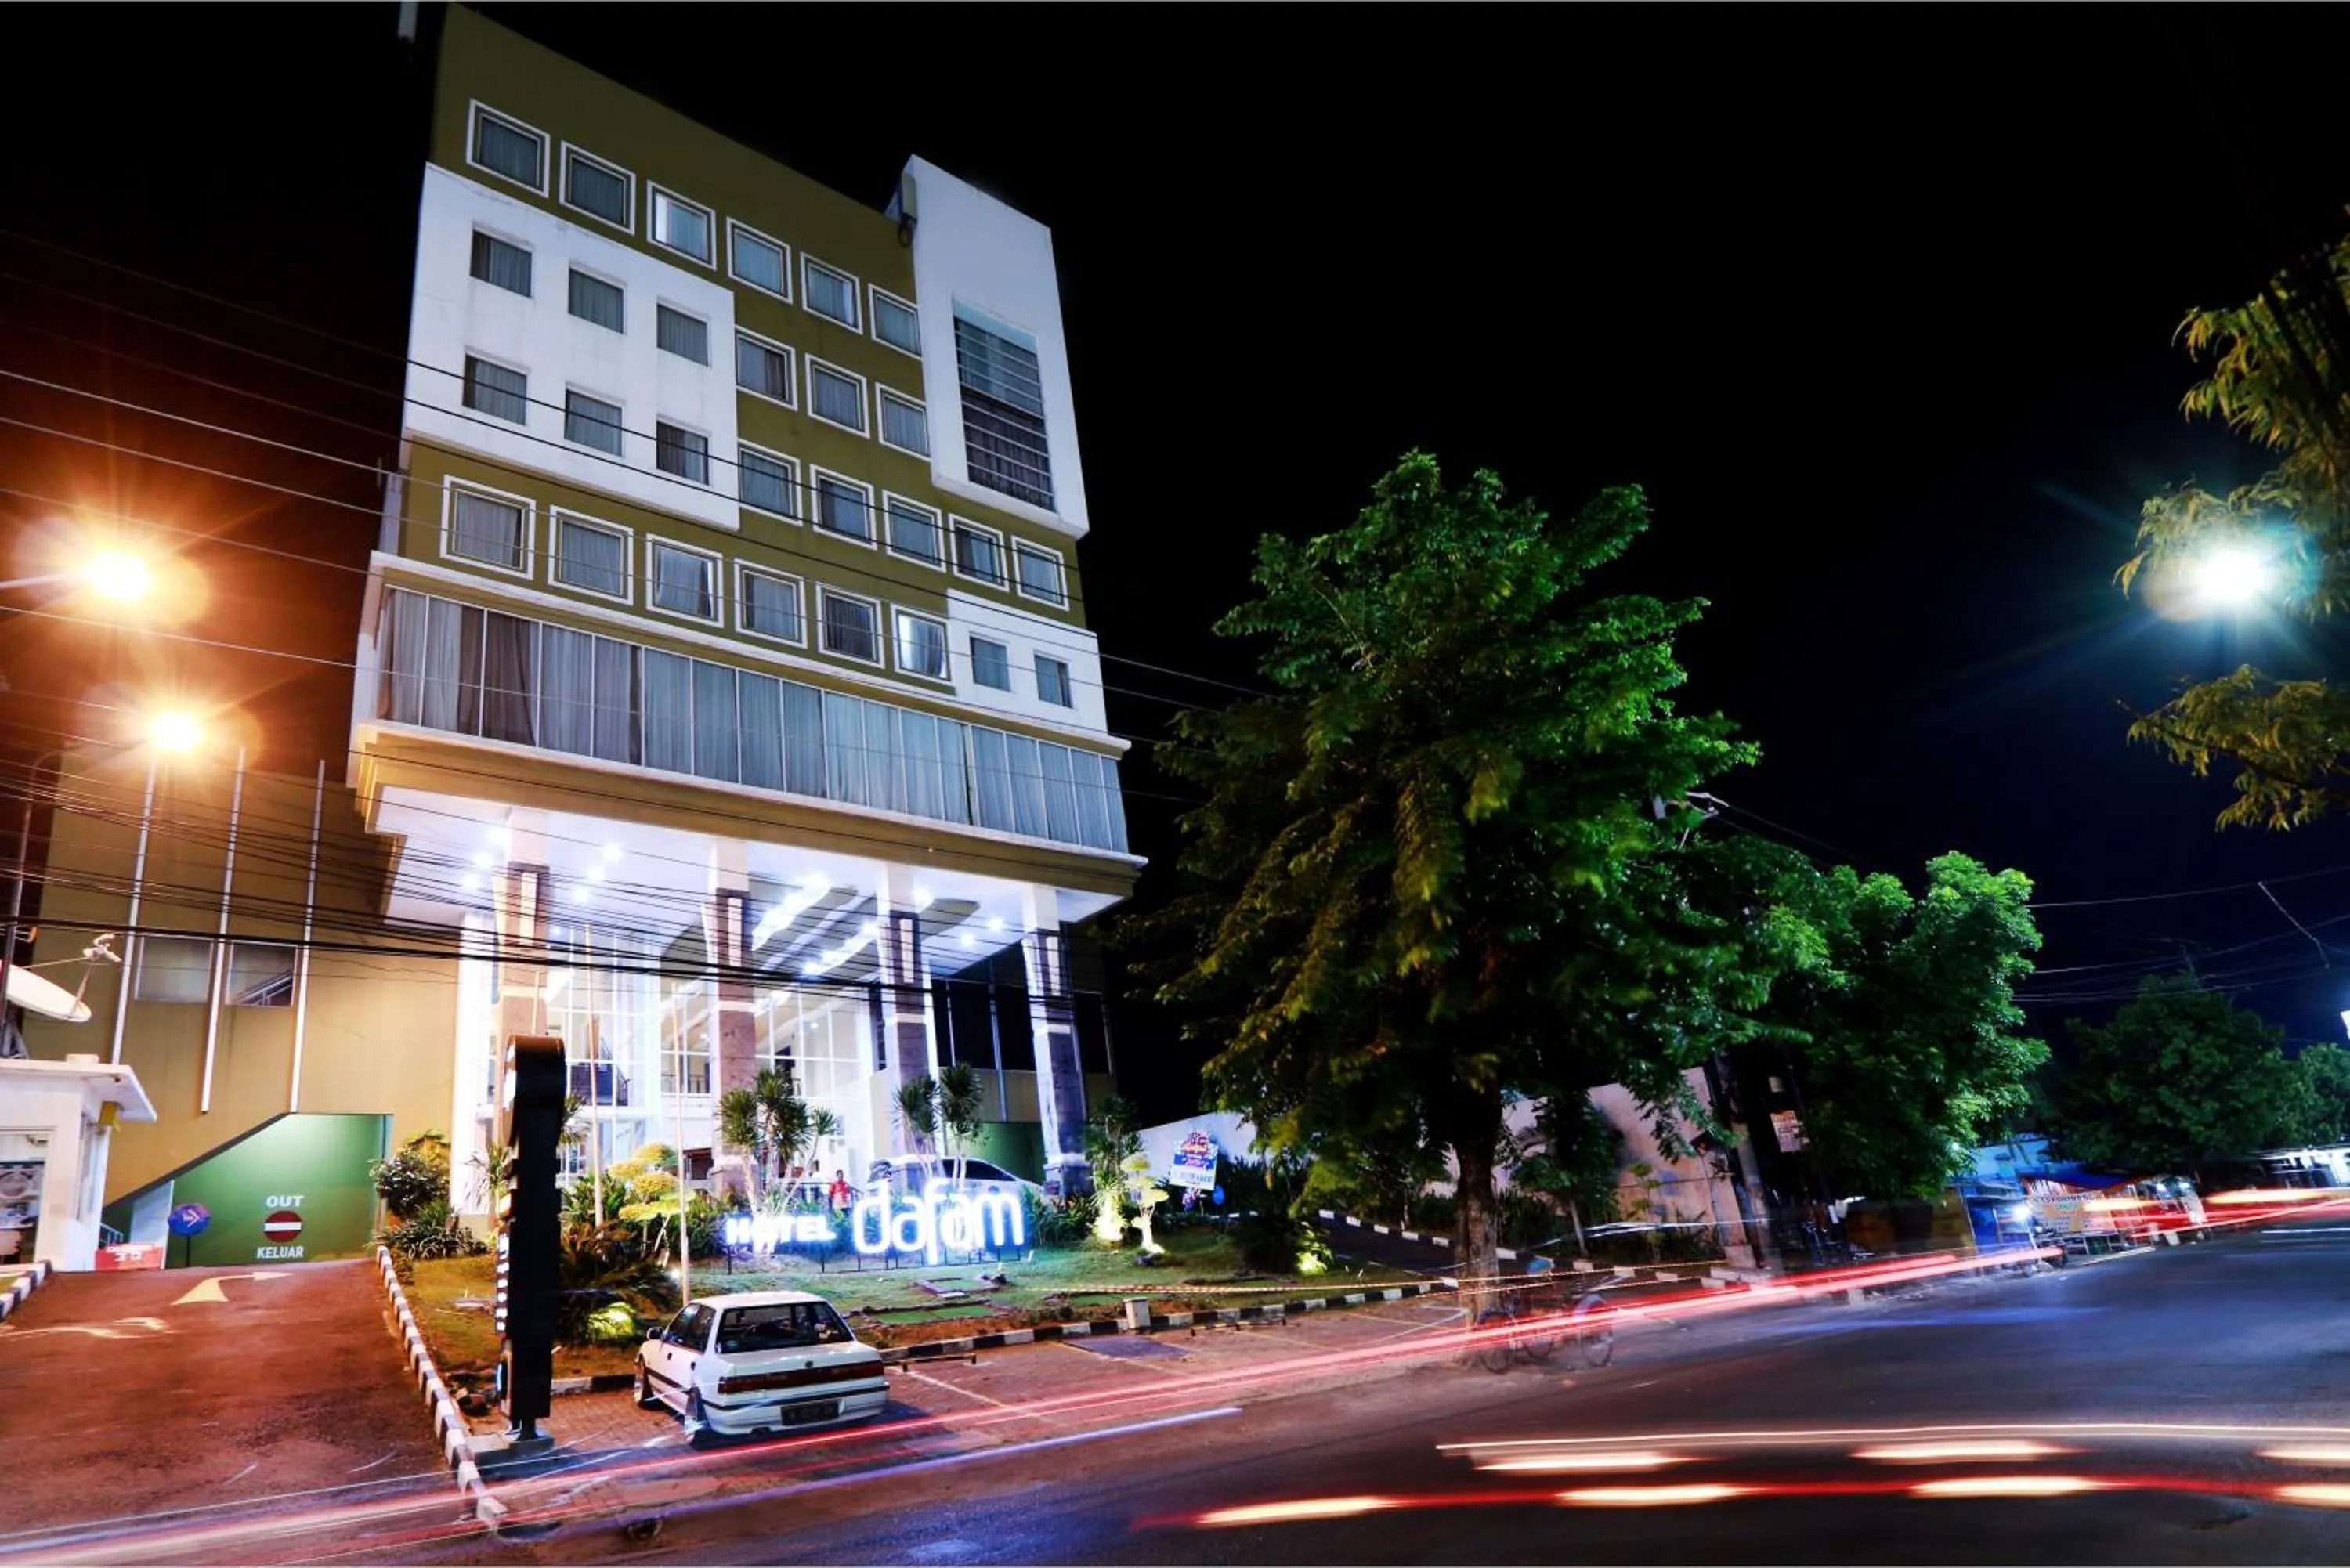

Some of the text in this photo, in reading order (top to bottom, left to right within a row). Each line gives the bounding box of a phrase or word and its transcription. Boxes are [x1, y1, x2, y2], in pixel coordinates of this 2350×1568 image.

[266, 1195, 304, 1207] OUT
[854, 1178, 1023, 1265] dafam
[257, 1245, 304, 1259] KELUAR
